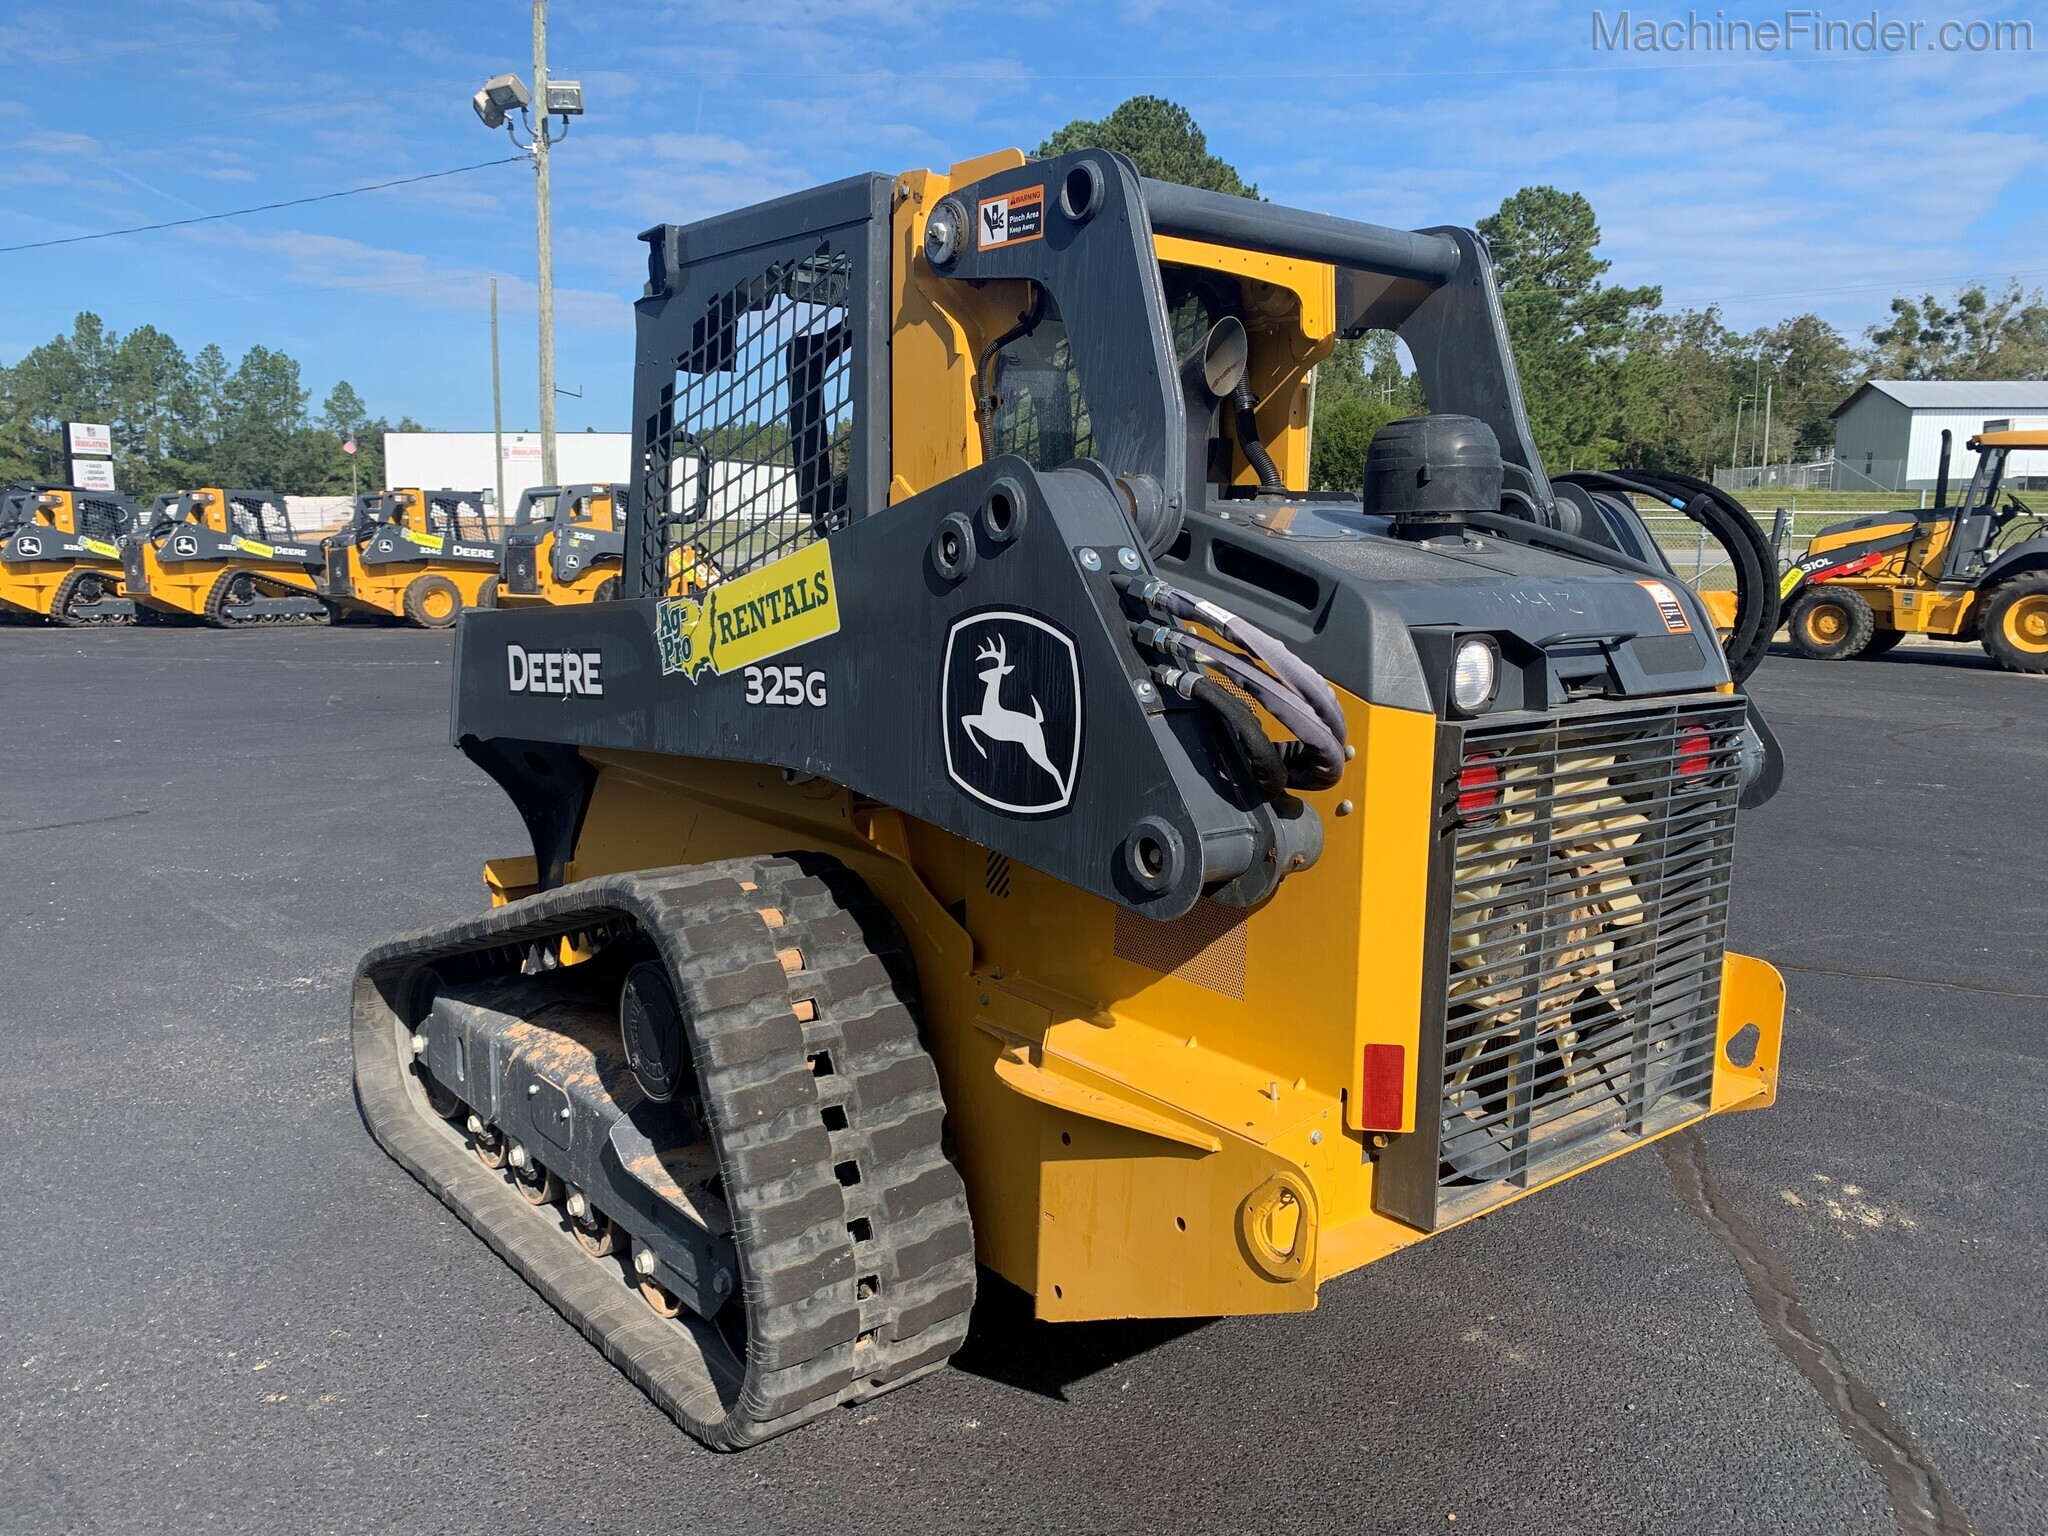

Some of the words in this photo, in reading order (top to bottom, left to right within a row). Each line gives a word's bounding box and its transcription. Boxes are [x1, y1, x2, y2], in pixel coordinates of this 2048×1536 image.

[1015, 191, 1040, 203] WARNING
[1009, 213, 1025, 224] Pinch
[1026, 211, 1039, 220] Area
[1009, 226, 1021, 234] Keep
[1022, 223, 1035, 231] Away
[75, 440, 108, 449] IRRIGATION
[274, 545, 307, 557] DEERE
[452, 545, 495, 558] DEERE
[1801, 557, 1834, 573] 310L
[718, 569, 829, 645] RENTALS
[662, 633, 694, 669] Pro
[507, 644, 603, 695] DEERE
[744, 666, 827, 708] 325G
